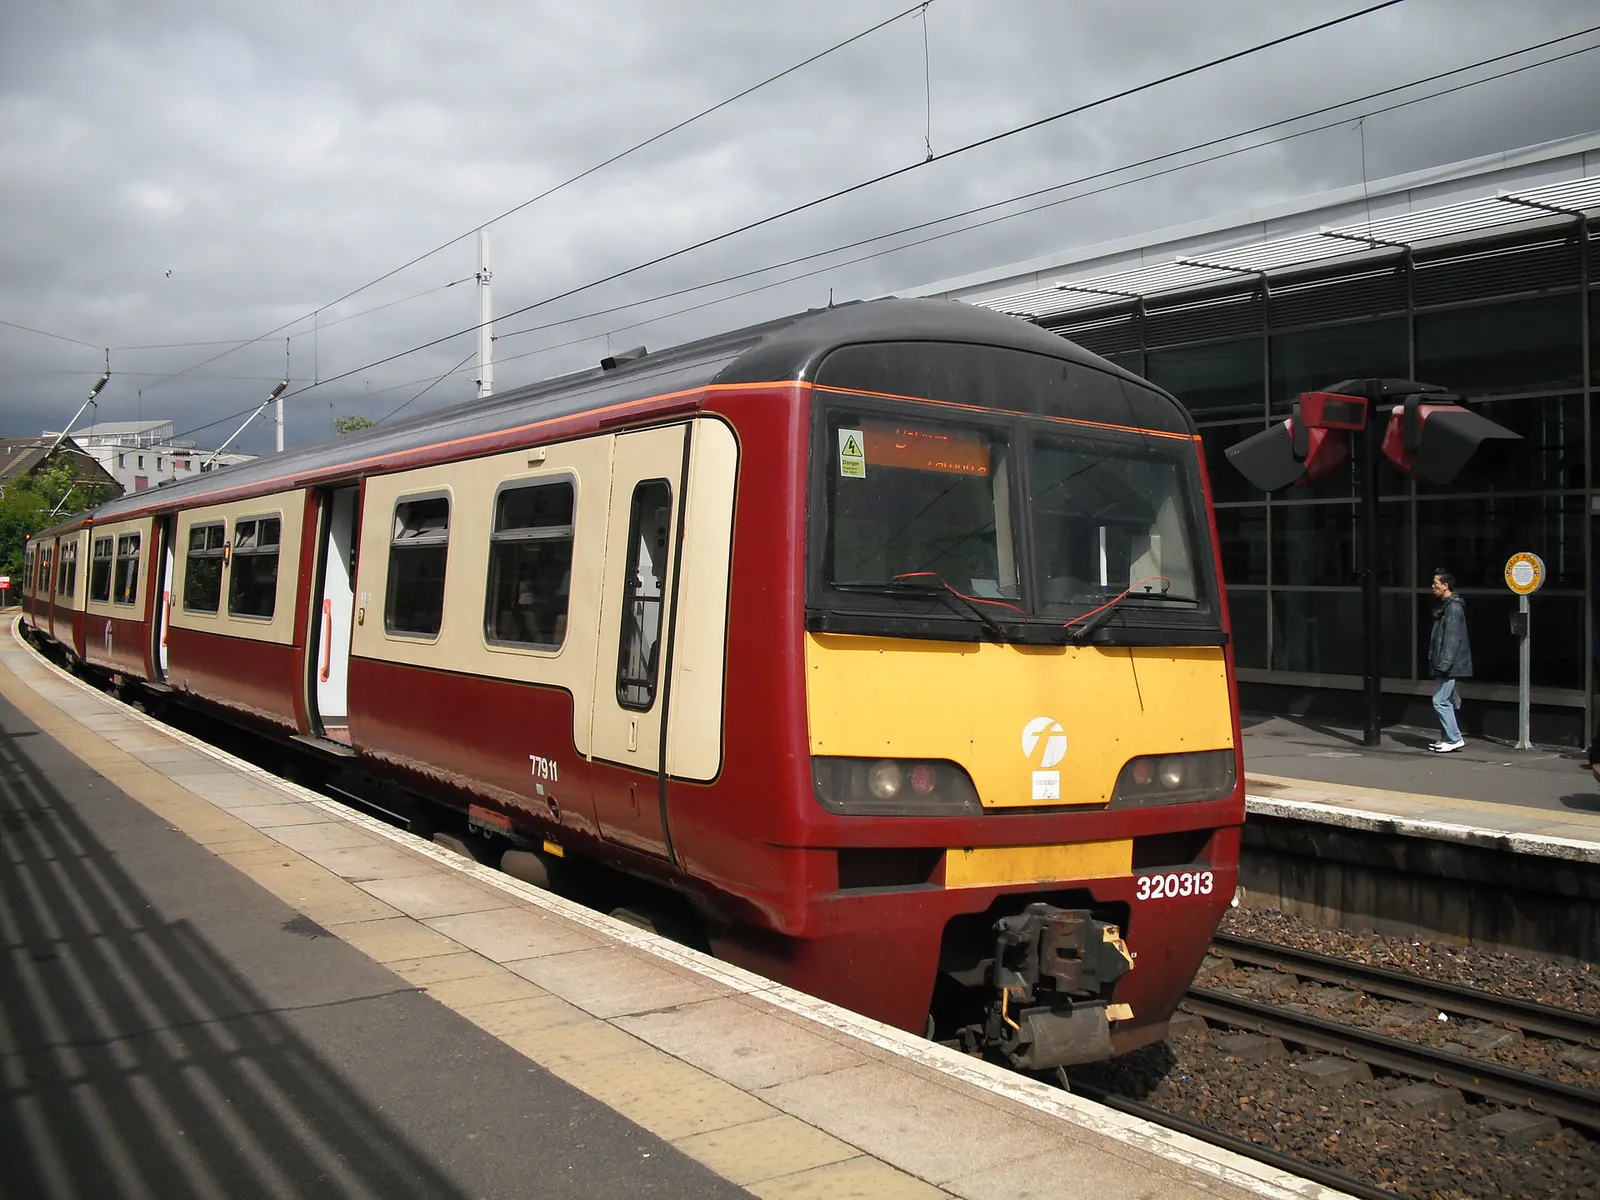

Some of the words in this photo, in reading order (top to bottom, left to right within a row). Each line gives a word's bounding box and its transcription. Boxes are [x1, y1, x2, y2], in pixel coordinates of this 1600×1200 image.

[1506, 554, 1520, 570] HELP
[1522, 554, 1539, 569] POINT
[529, 754, 558, 782] 77911
[1136, 871, 1214, 900] 320313
